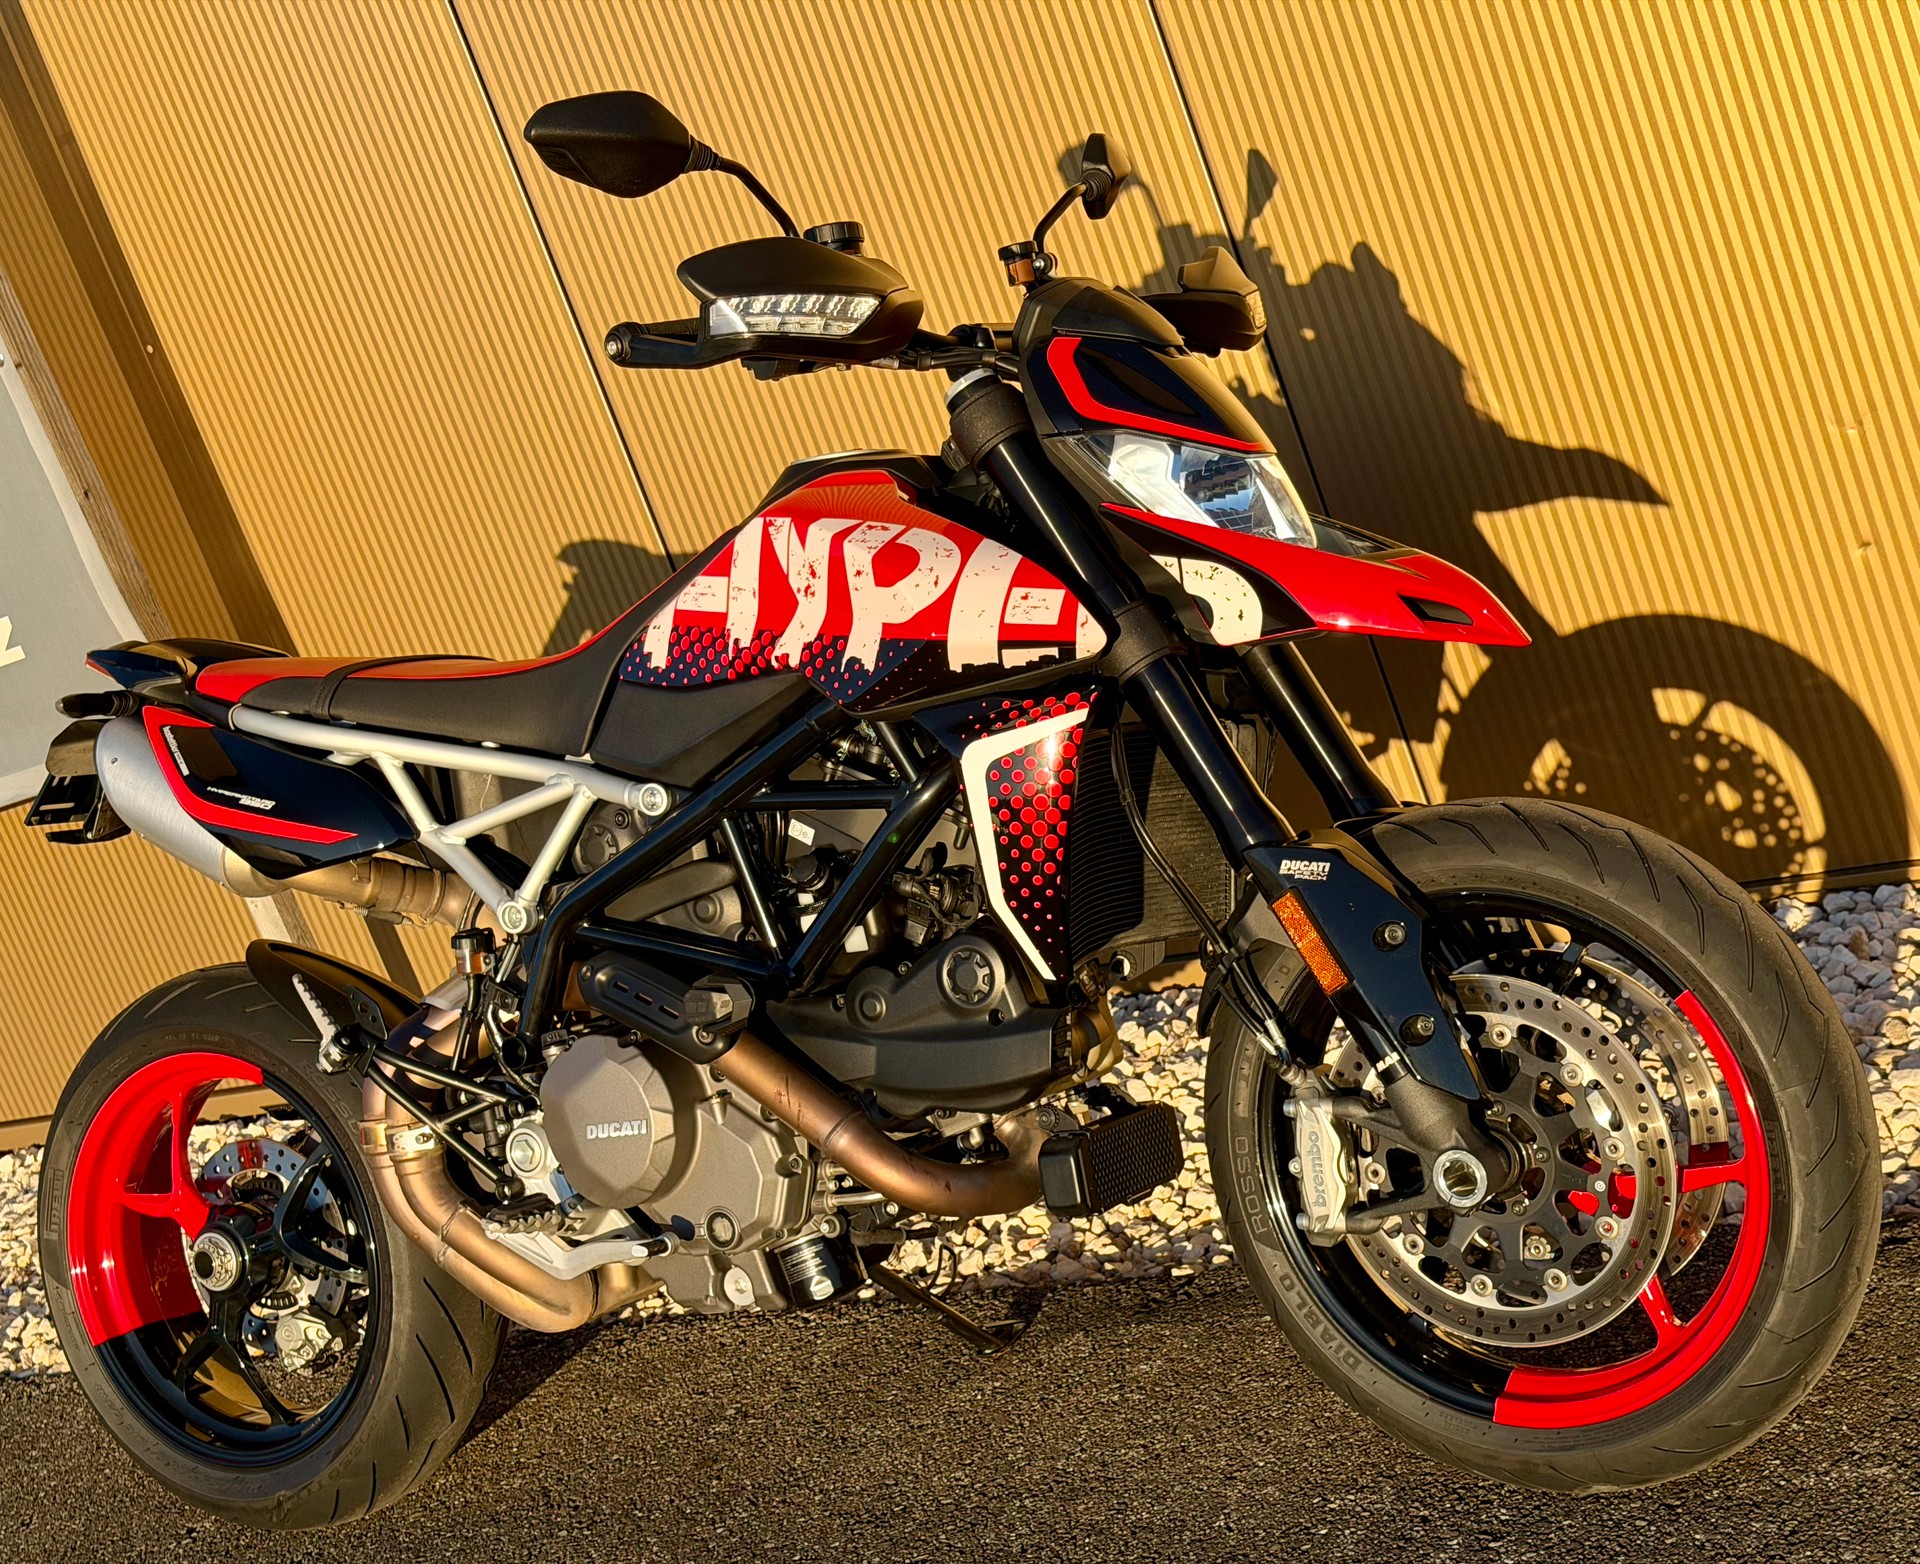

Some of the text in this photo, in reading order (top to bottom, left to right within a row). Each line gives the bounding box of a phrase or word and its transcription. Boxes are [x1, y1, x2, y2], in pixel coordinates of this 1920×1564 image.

[1280, 860, 1331, 872] DUCATI
[586, 1119, 648, 1141] DUCATI
[1307, 1130, 1328, 1208] brembo
[1234, 1136, 1270, 1235] ROSSO
[1276, 1272, 1364, 1374] DIABLO
